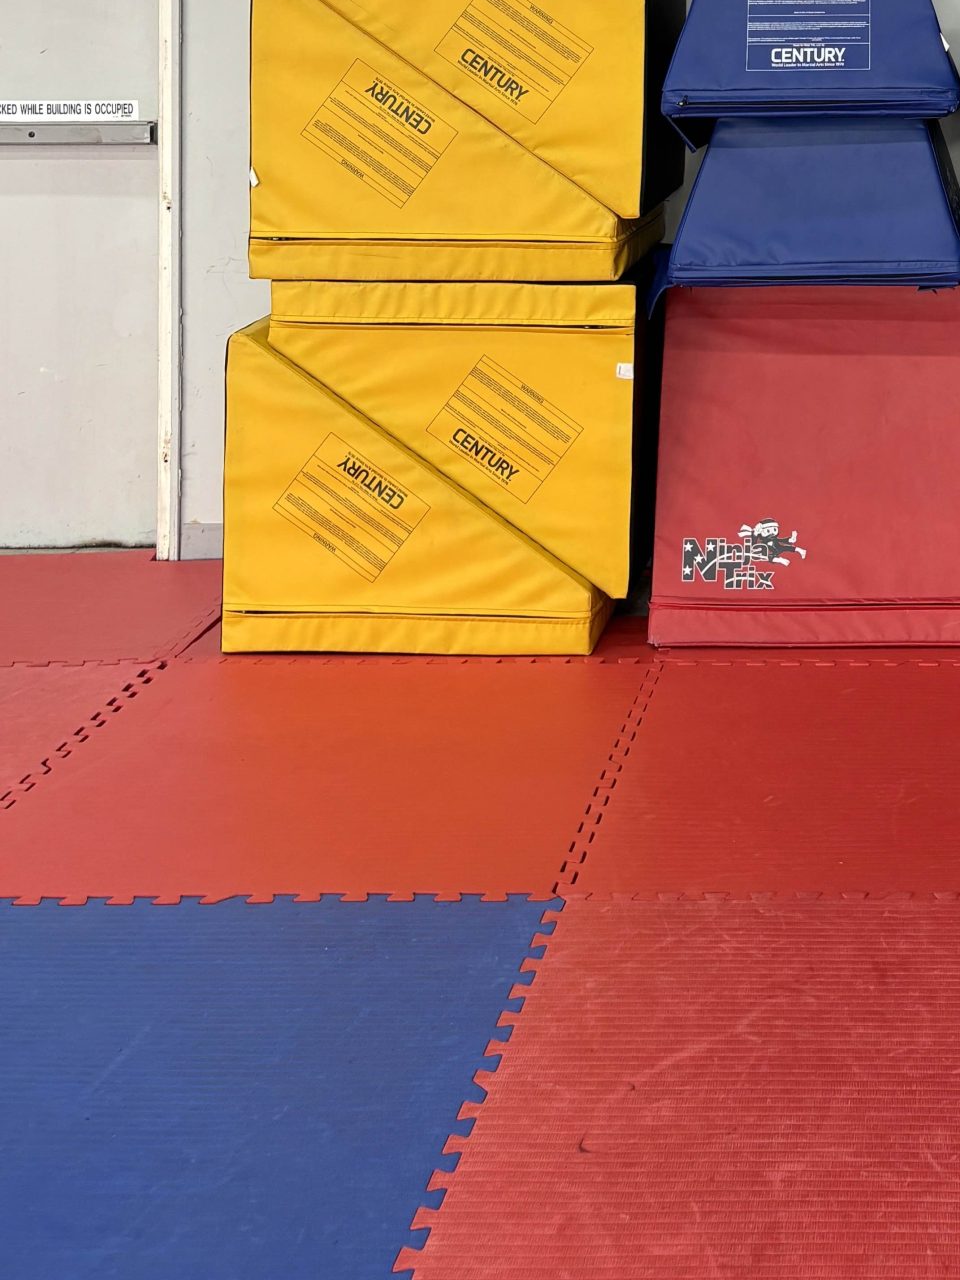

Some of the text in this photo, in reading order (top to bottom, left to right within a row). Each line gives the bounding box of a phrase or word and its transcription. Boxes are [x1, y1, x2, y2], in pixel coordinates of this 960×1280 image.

[529, 3, 554, 25] WARNING
[771, 47, 846, 63] CENTURY
[460, 48, 530, 101] CENTURY
[20, 103, 44, 115] WHILE
[46, 103, 82, 115] BUILDING
[84, 103, 92, 115] IS
[94, 102, 134, 115] OCCUPIED
[365, 79, 433, 135] CENTURY
[341, 159, 366, 180] WARNING
[520, 383, 545, 405] WARNING
[452, 428, 520, 481] CENTURY
[337, 454, 406, 510] CENTURY
[312, 531, 337, 553] WARNING
[682, 537, 770, 582] Ninja
[717, 562, 775, 590] Trix
